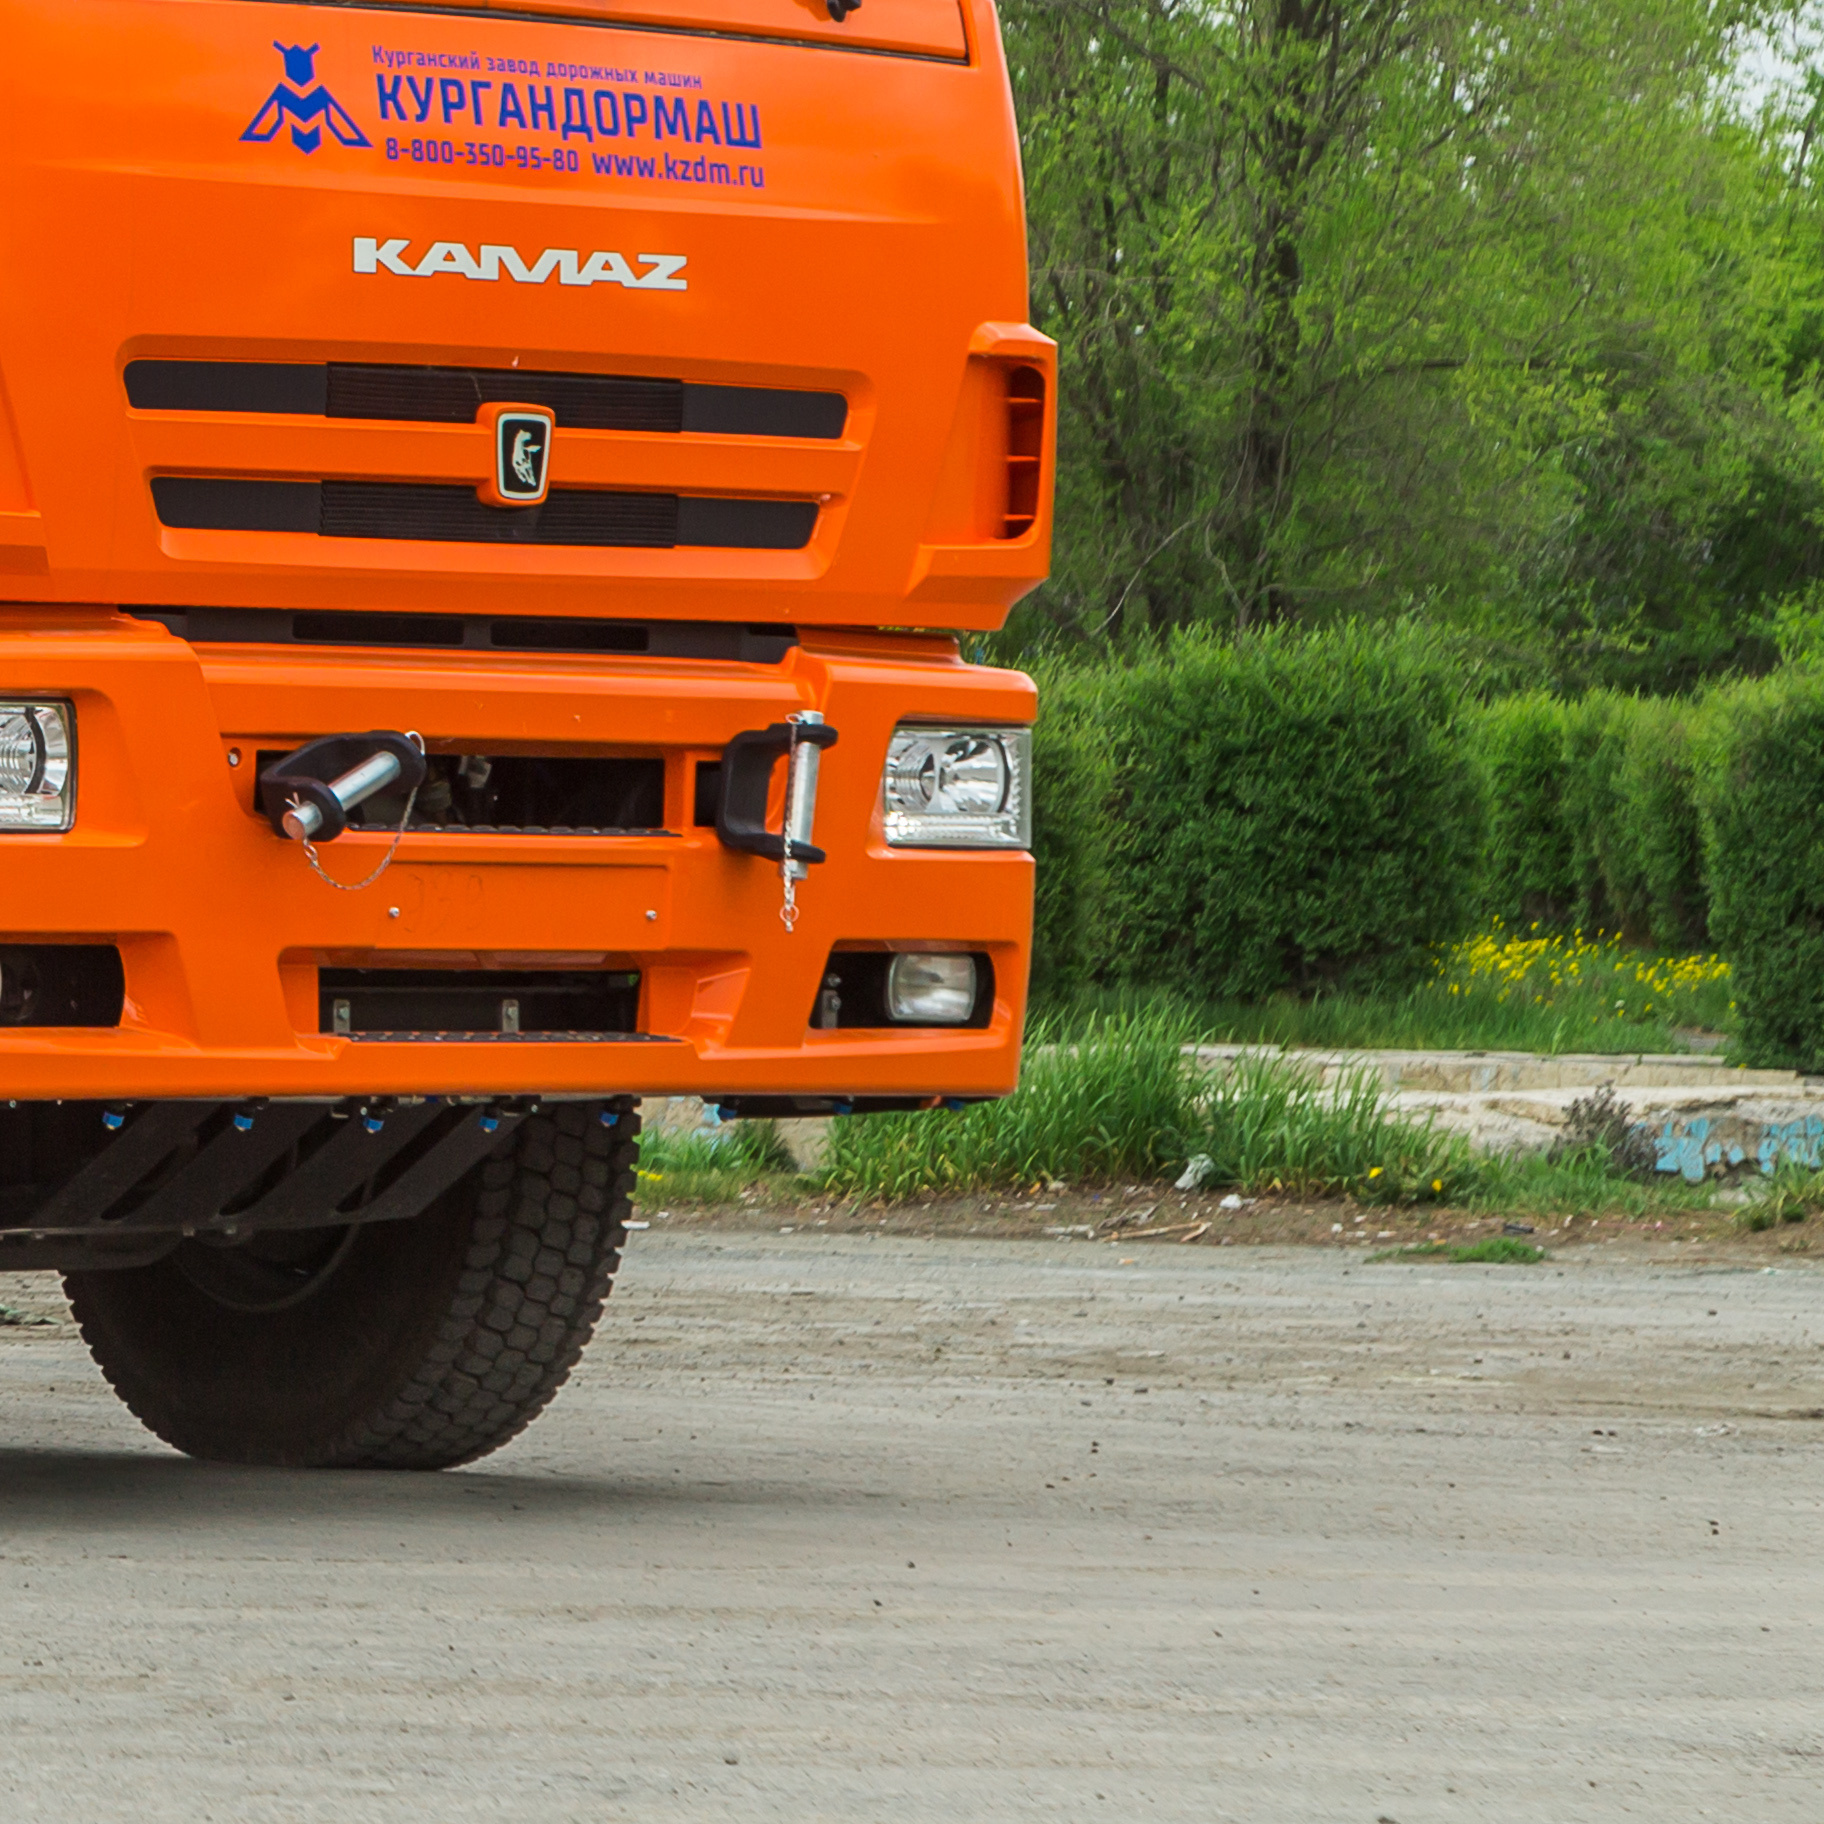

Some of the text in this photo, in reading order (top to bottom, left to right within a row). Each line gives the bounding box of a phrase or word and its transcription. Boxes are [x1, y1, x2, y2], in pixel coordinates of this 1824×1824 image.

[371, 45, 703, 90] Курганский завод дорожных машин
[375, 73, 763, 150] КУРГАНДОРМАШ
[386, 137, 765, 188] 8-800-350-95-80 www.kzdm.ru
[353, 237, 687, 291] KAMAZ
